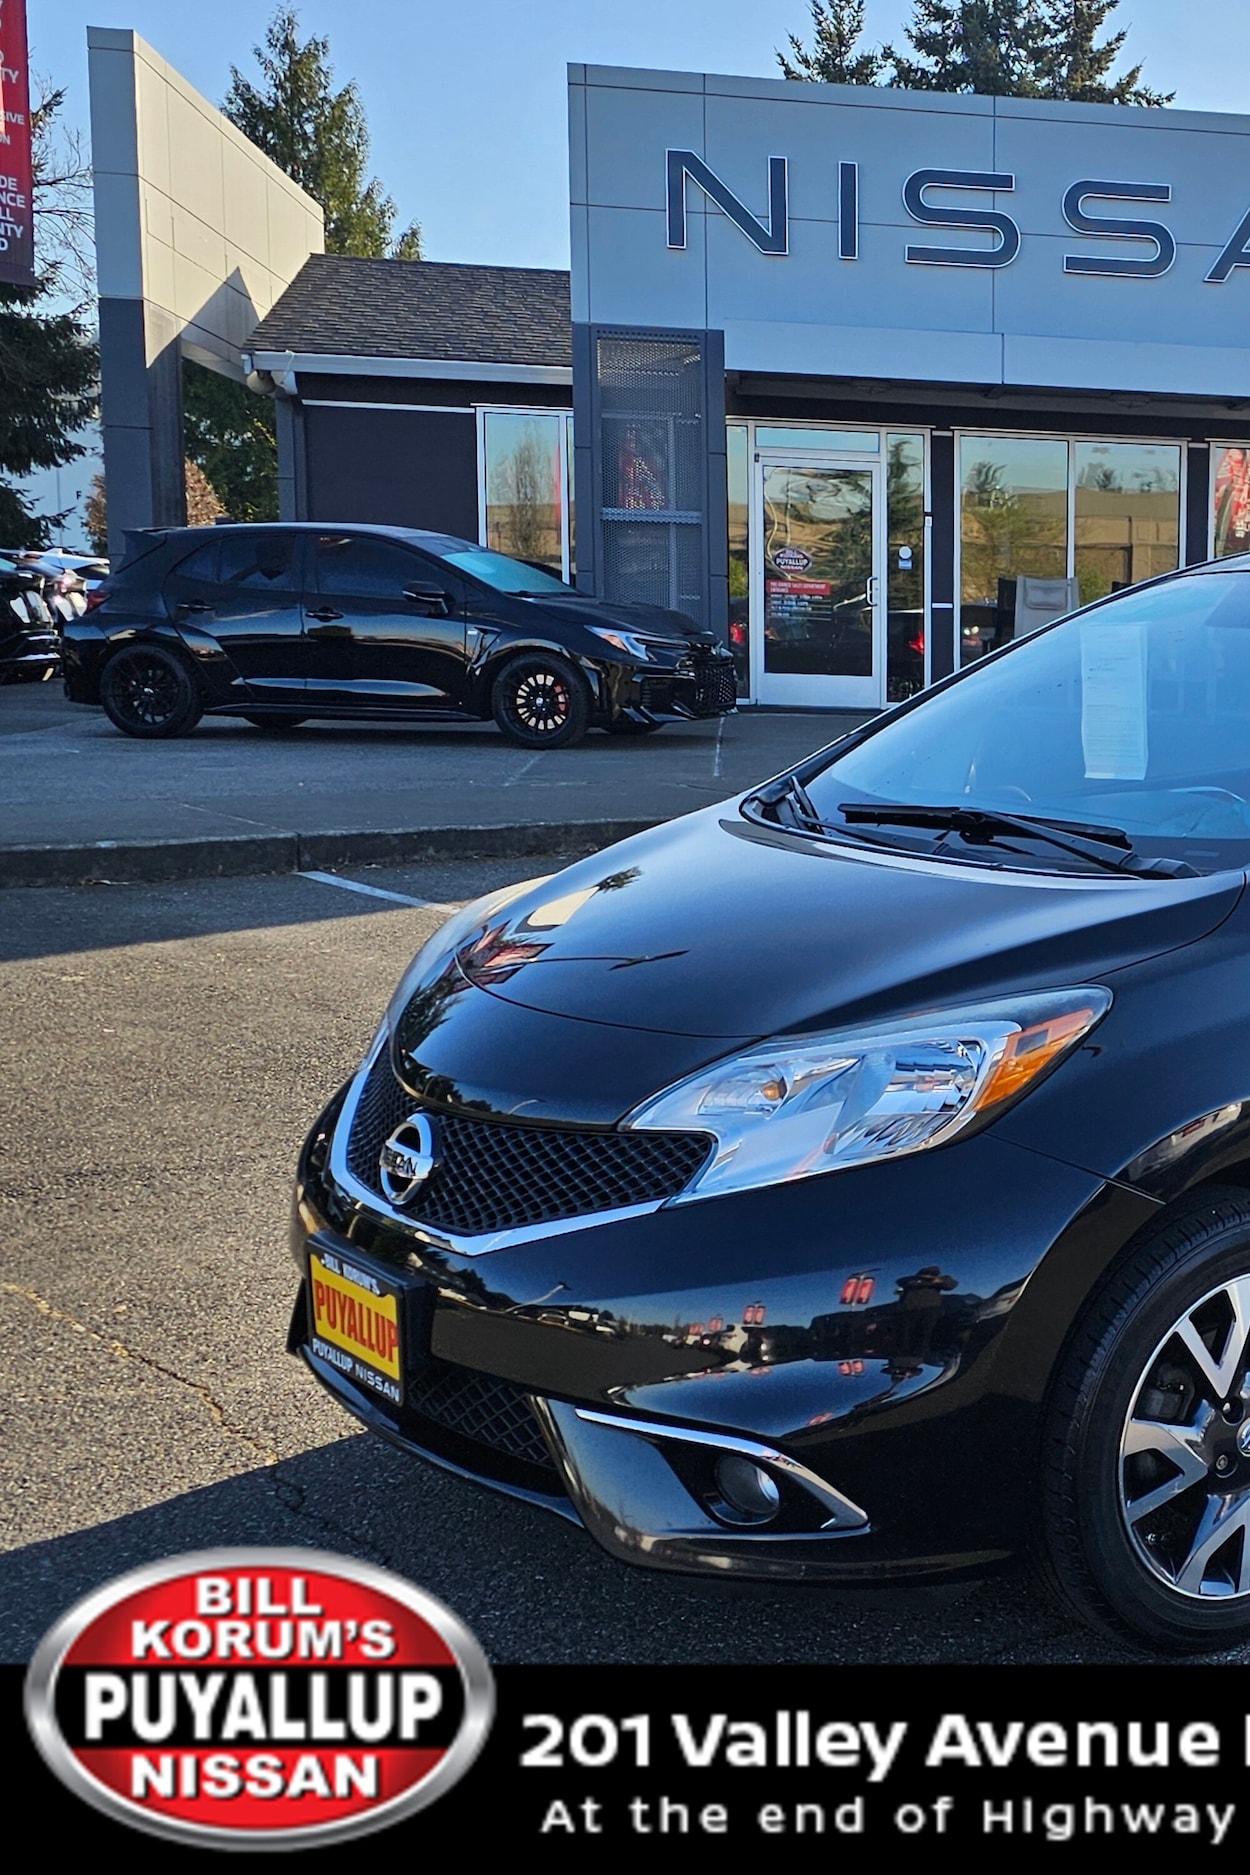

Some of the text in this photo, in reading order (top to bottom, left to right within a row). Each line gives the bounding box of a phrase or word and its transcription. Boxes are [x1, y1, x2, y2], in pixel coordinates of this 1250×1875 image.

[313, 1278, 399, 1364] PUYALLUP
[312, 1338, 400, 1403] PUYALLUP NISSAN
